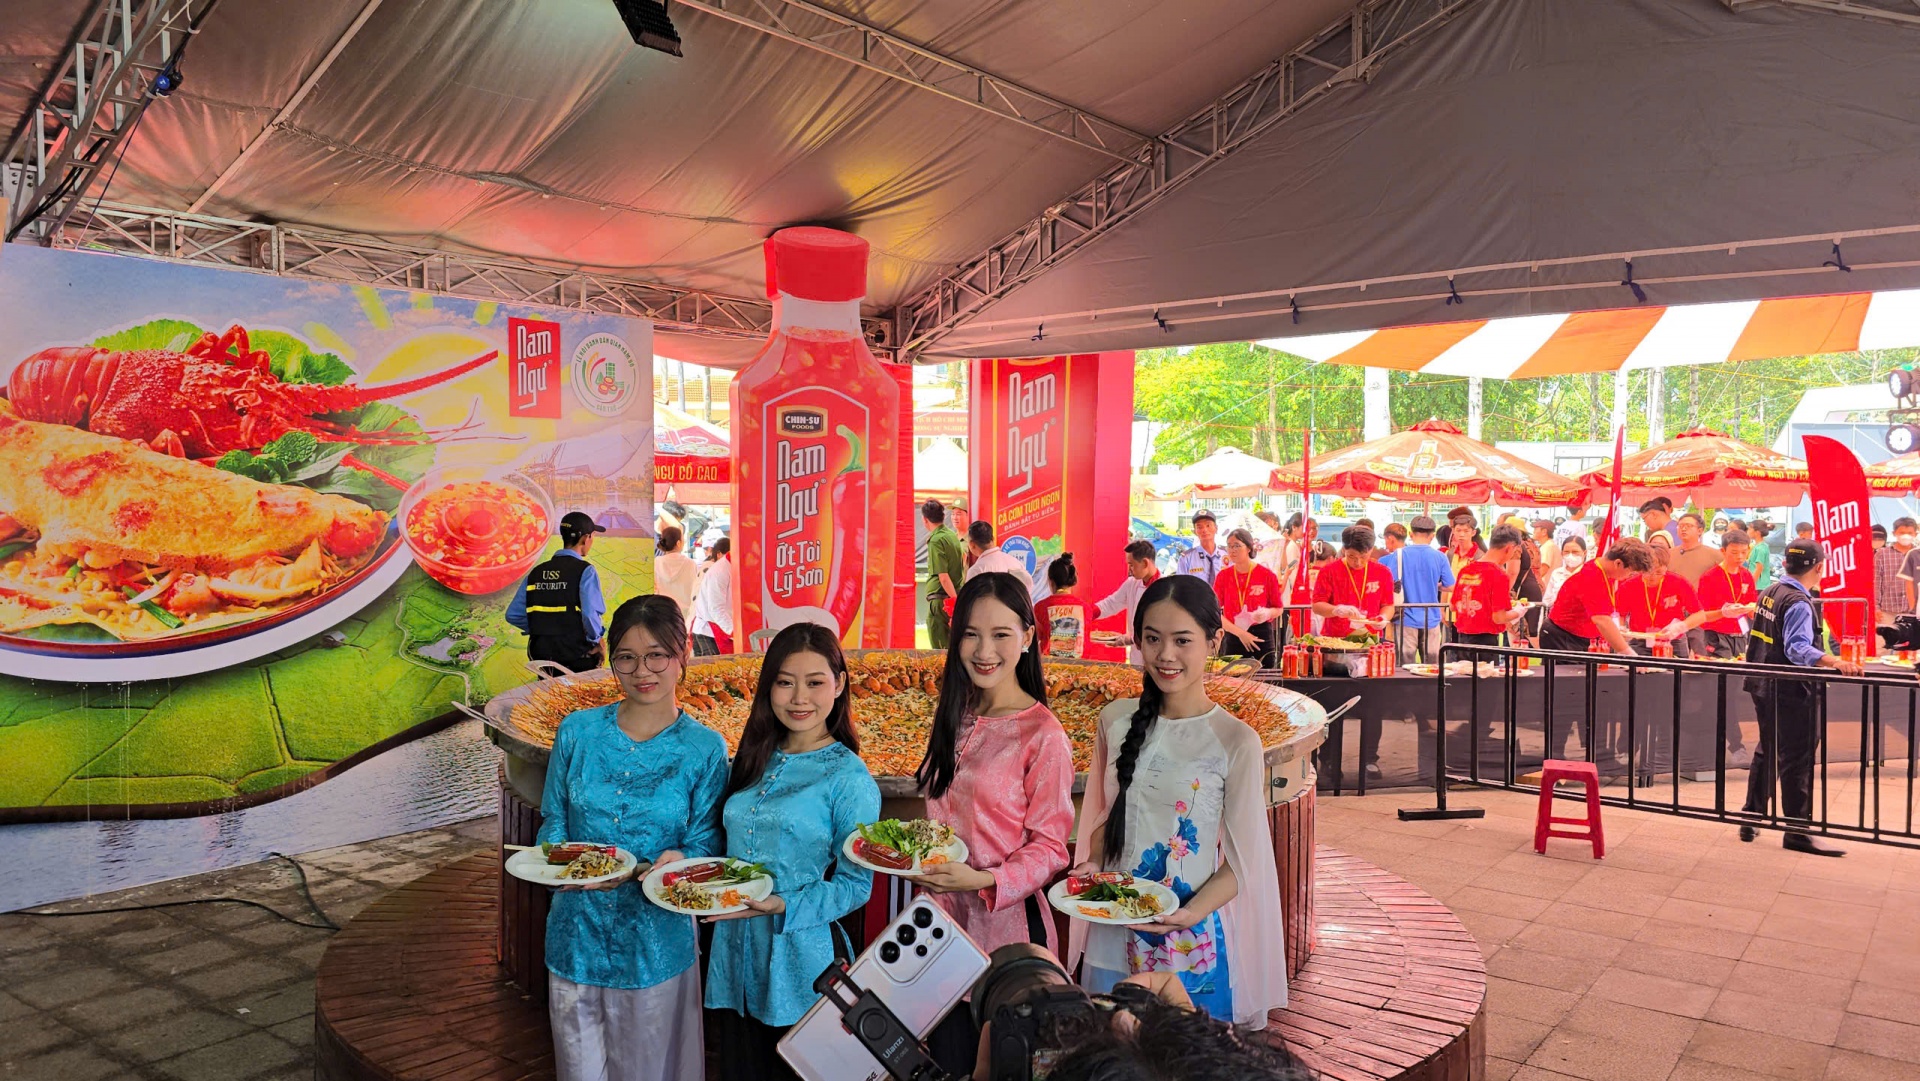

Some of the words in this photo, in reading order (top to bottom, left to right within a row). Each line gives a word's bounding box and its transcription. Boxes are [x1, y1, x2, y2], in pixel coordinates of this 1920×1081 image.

[517, 325, 551, 360] Nam
[518, 361, 547, 410] Ngư
[1008, 371, 1056, 424] Nam
[785, 415, 820, 424] CHIN-SU
[698, 465, 718, 481] CAO
[777, 440, 826, 482] Nam
[1008, 422, 1048, 498] Ngư
[1040, 490, 1060, 508] NGON
[1378, 479, 1399, 492] NAM
[1439, 484, 1458, 496] CAO
[777, 481, 819, 540] Ngư
[1816, 500, 1859, 538] Nam
[542, 570, 560, 580] USS
[796, 565, 823, 589] Sơn
[882, 1036, 905, 1059] Ulanzi
